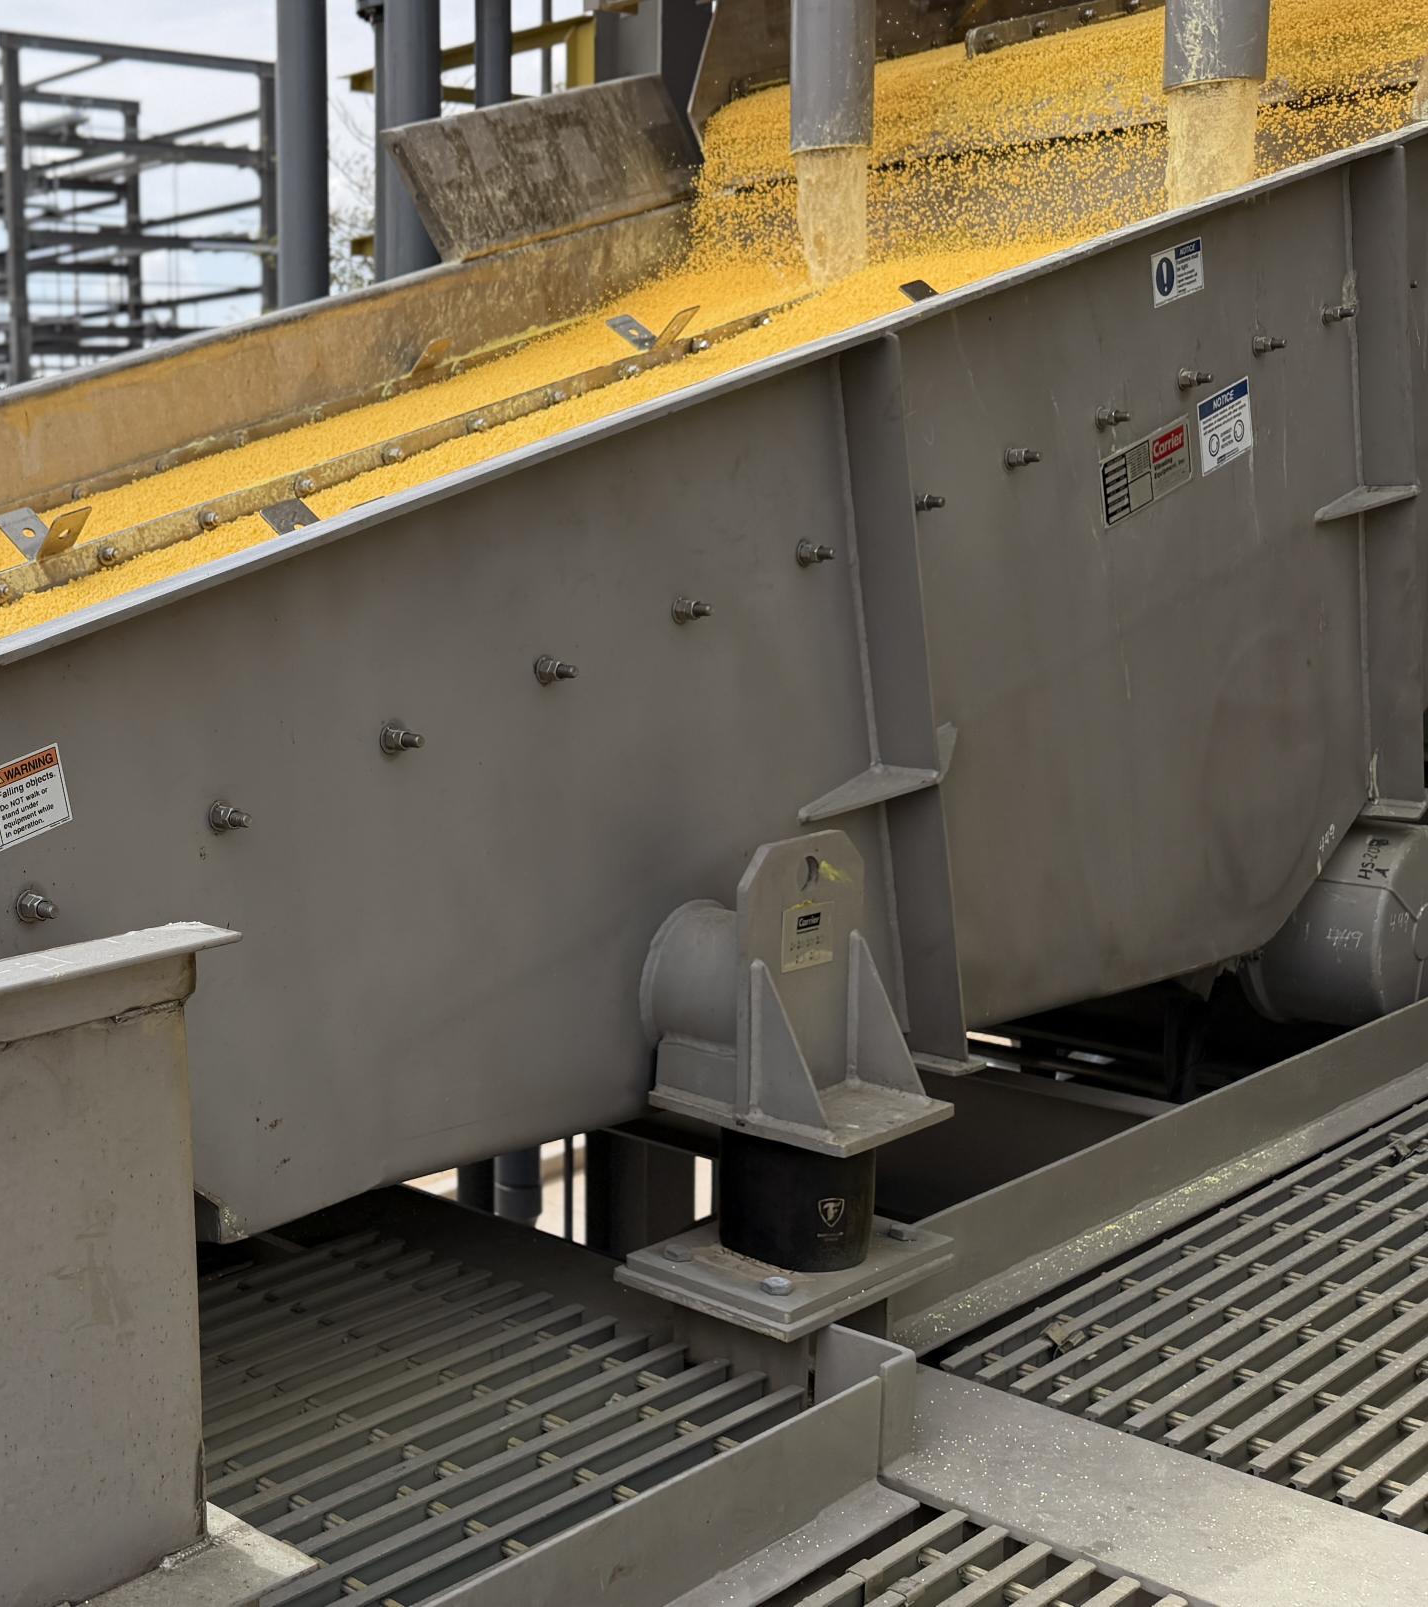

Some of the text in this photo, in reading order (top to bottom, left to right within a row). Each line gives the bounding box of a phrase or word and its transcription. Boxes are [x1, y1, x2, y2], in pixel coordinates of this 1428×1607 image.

[1179, 243, 1196, 255] NOTICE
[1213, 389, 1235, 410] NOTICE
[1153, 431, 1183, 457] Carrier
[4, 753, 54, 781] WARNING
[25, 771, 56, 789] objects.
[0, 787, 48, 812] Do NOT walk or
[1, 801, 39, 821] stand under
[3, 810, 37, 830] equipment
[37, 803, 54, 814] while
[13, 819, 45, 837] operation.
